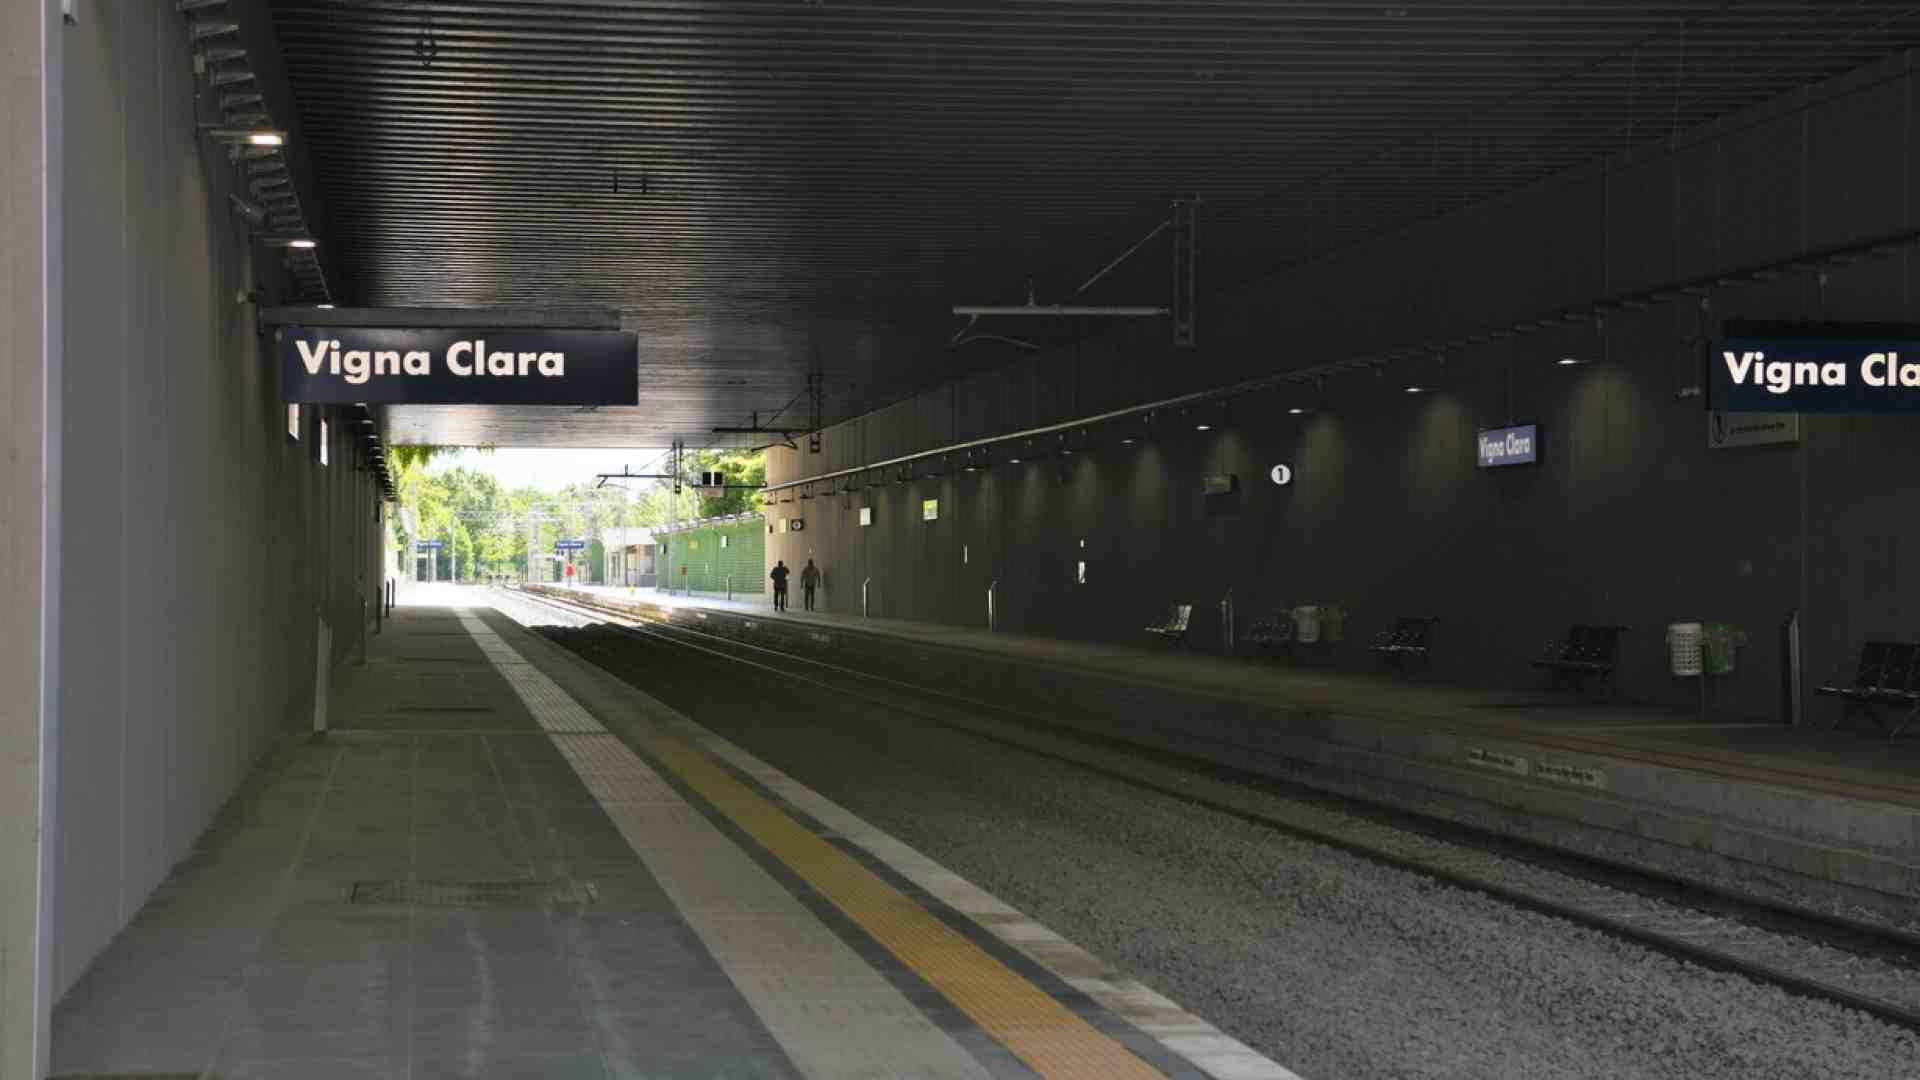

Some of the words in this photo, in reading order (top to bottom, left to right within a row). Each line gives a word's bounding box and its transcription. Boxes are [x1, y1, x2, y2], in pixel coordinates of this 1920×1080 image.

[297, 340, 430, 384] Vigna
[447, 340, 565, 376] Clara
[1722, 352, 1847, 394] Vigna
